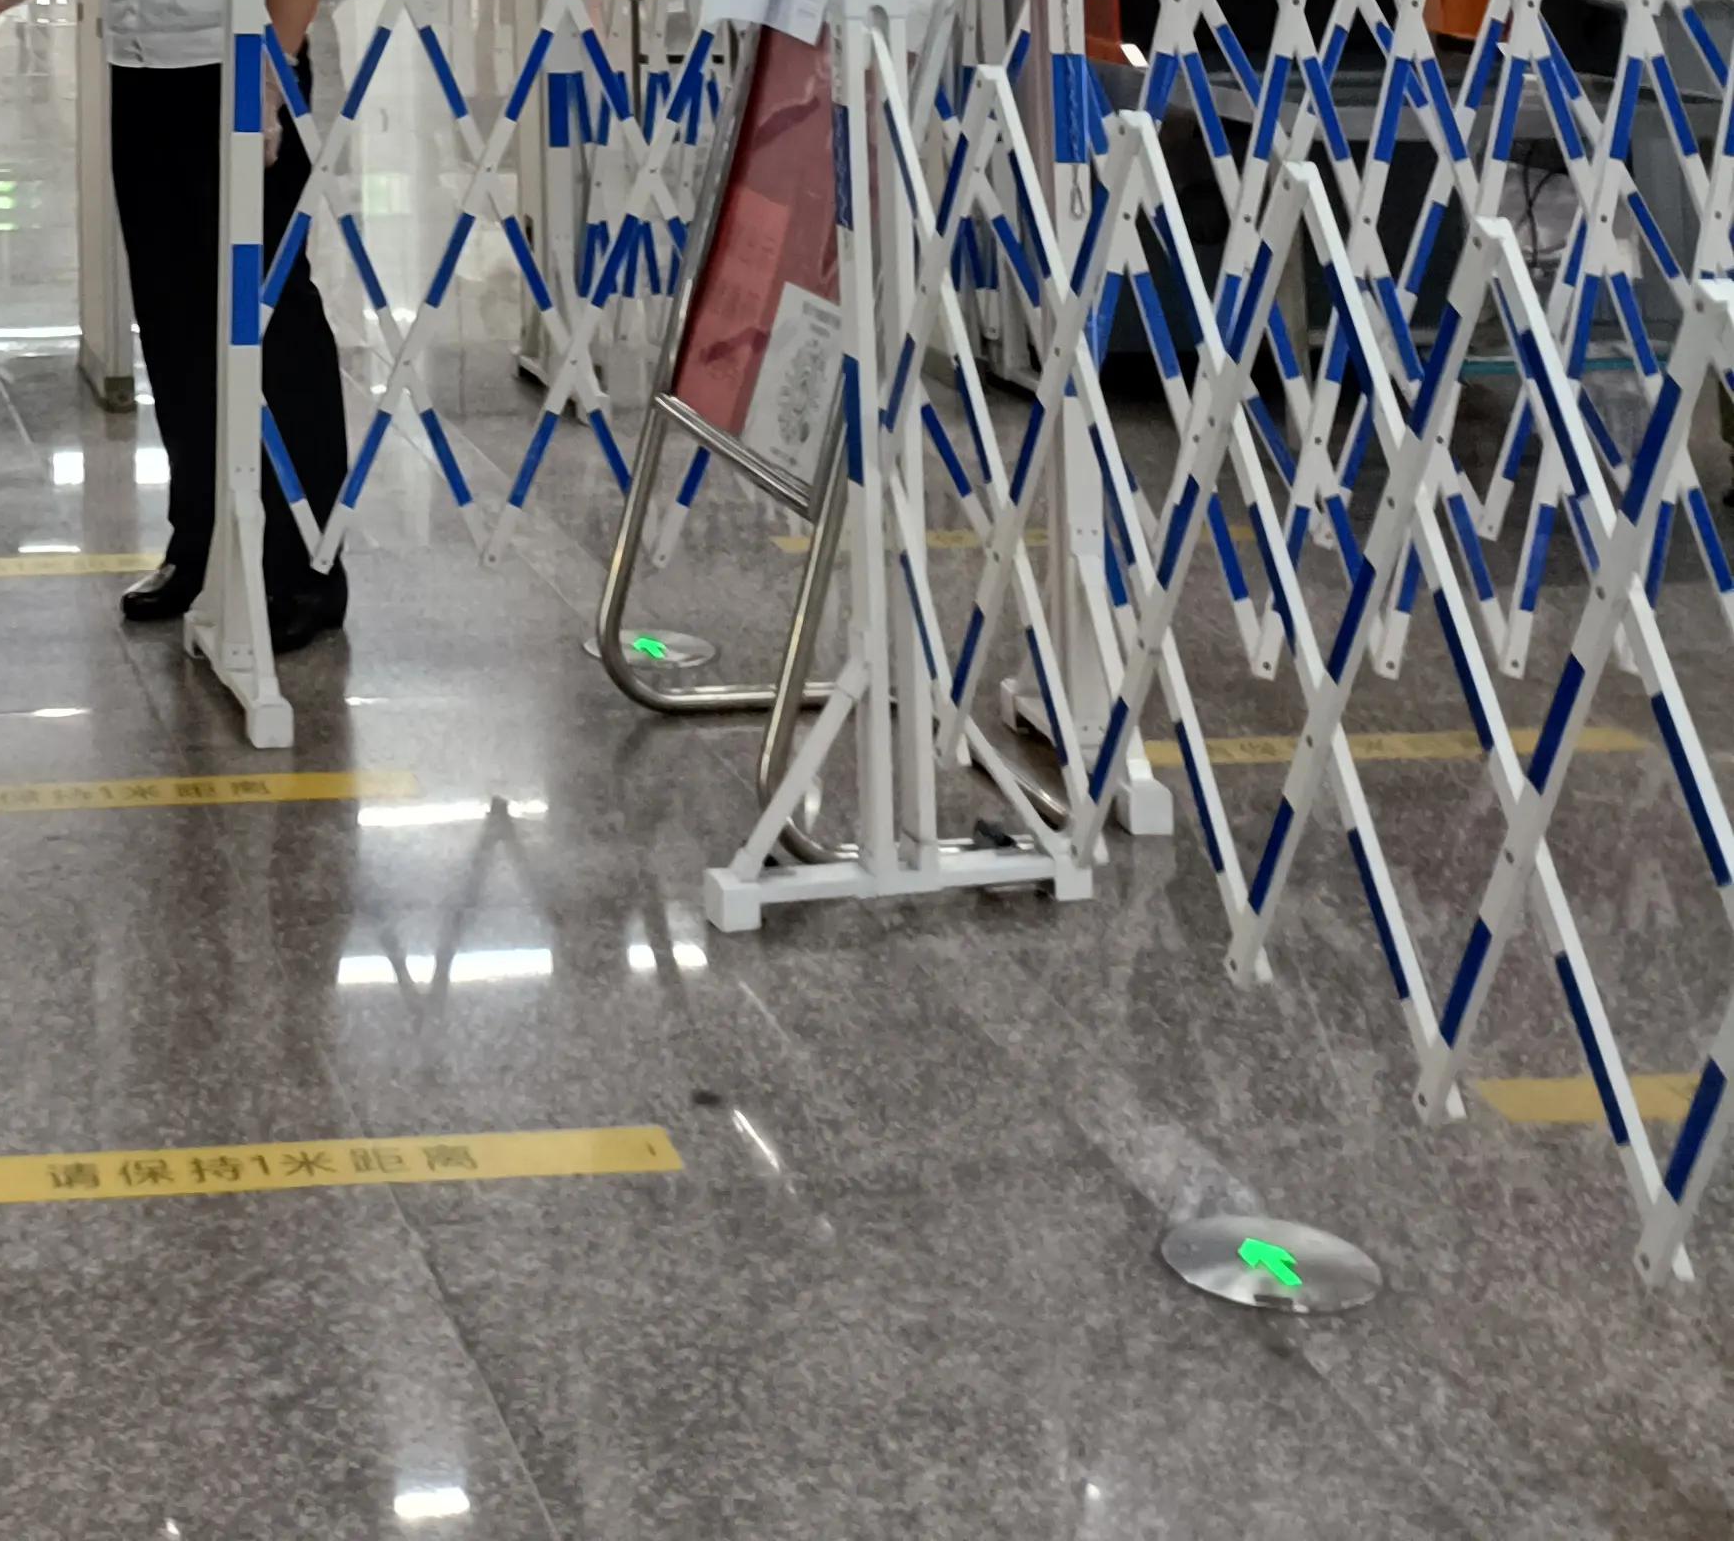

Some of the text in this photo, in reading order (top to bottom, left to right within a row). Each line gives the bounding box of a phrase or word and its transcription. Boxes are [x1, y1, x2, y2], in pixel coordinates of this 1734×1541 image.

[48, 1143, 479, 1190] 请保持1米距离
